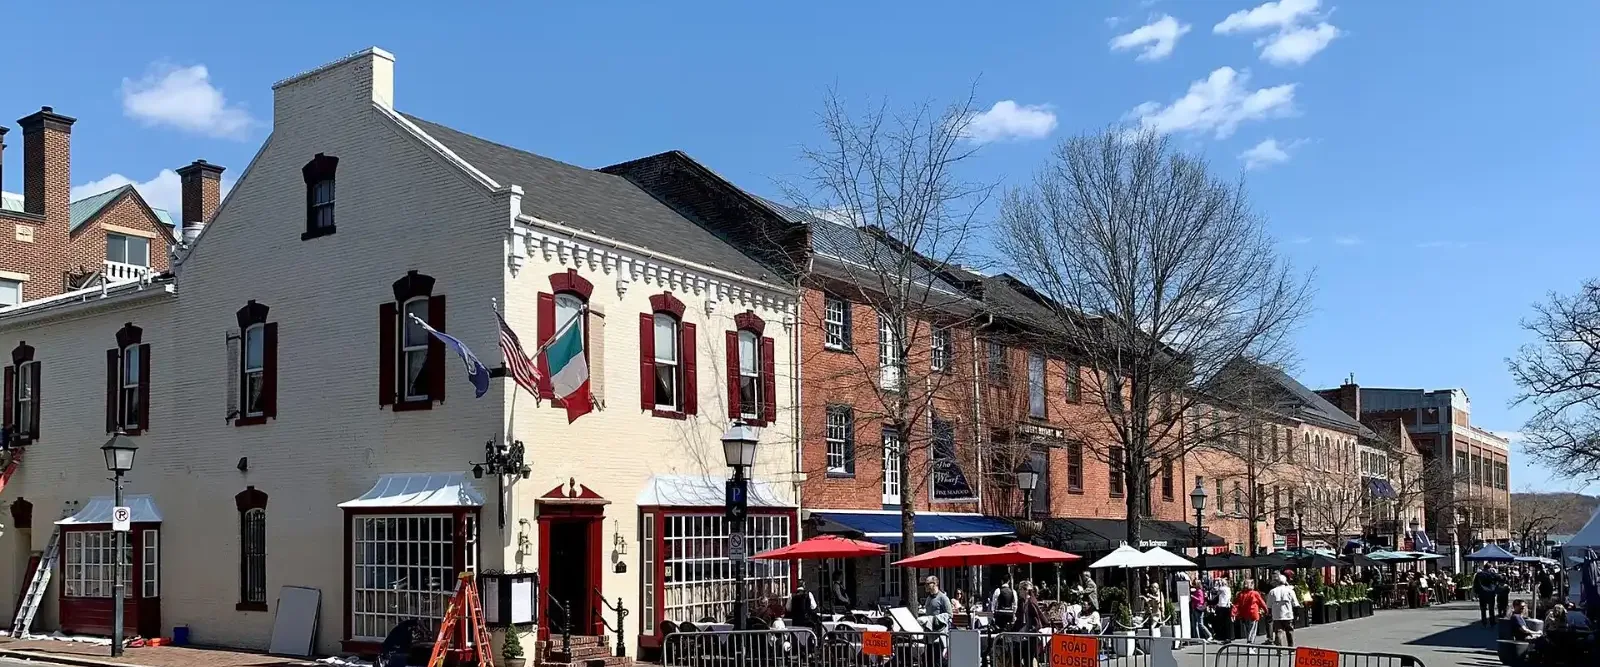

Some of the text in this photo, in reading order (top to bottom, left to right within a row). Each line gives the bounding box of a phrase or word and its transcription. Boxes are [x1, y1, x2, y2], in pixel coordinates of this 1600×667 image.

[937, 460, 951, 468] The
[935, 472, 960, 486] Wharf
[732, 487, 741, 501] P
[865, 639, 888, 648] CLOSED
[1061, 641, 1087, 653] ROAD
[1309, 650, 1325, 658] ROAD
[1053, 653, 1095, 667] CLOSED
[1299, 657, 1335, 667] CLOSED
